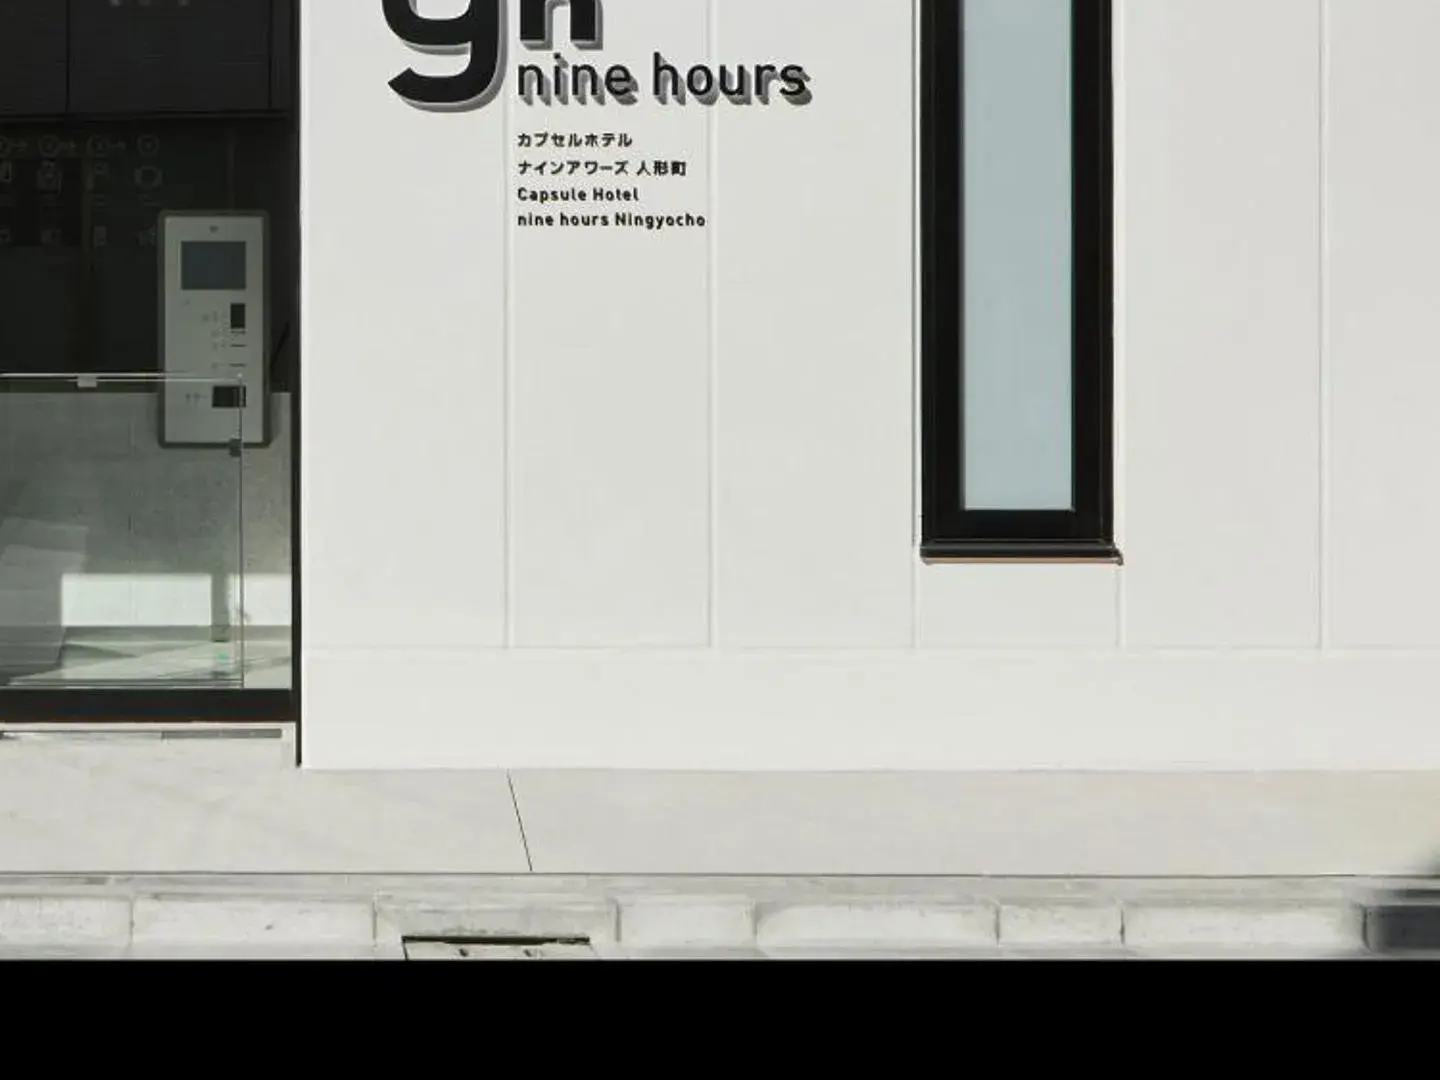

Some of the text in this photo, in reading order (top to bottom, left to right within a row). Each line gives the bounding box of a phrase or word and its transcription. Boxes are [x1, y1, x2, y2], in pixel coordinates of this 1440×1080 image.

[517, 51, 807, 98] nine hours
[517, 131, 633, 149] カプセルホテル
[517, 159, 688, 178] ナインアワーズ 人形町
[516, 187, 640, 205] Capsule Hotel
[516, 212, 707, 231] nine hours Ningyocho
